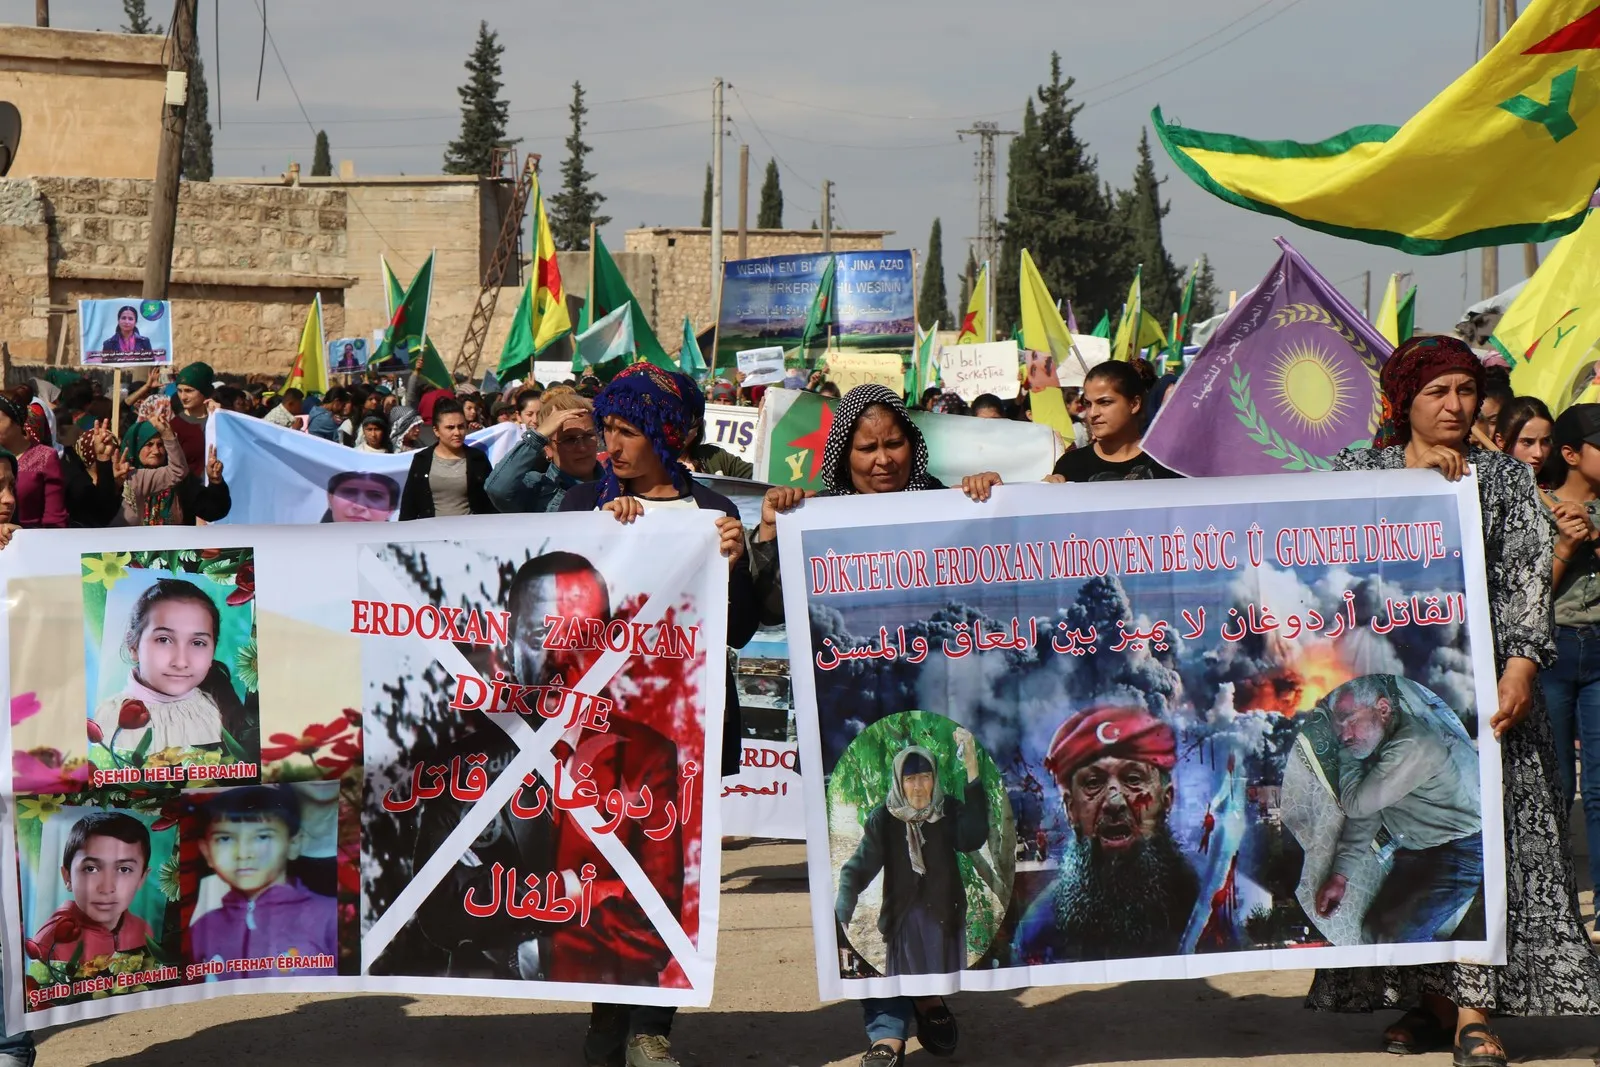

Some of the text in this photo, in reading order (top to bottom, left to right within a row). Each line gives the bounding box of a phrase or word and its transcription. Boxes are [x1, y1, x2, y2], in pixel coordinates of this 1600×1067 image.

[737, 263, 774, 275] WERIN
[779, 262, 796, 273] EM
[801, 261, 812, 273] BI
[850, 259, 876, 271] JINA
[880, 259, 904, 270] AZAD
[943, 349, 982, 369] Ji beli
[1215, 332, 1243, 365] الحرة
[1192, 363, 1222, 409] للشهباء
[933, 542, 1044, 587] ERDOXAN
[1159, 526, 1189, 572] BÊ
[1192, 523, 1237, 571] SÛC
[1247, 522, 1264, 568] Û
[1275, 525, 1360, 569] GUNEH
[350, 599, 699, 660] ERDOXAN ZAROKAN
[816, 590, 1465, 671] القاتل أردوغان لا يميز بين المعاق والمسن
[94, 761, 257, 788] ŞEHÎD HELE ÊBRAHÎM
[381, 752, 698, 841] أردوغان قاتل
[463, 862, 598, 927] أطفال
[30, 966, 178, 1007] ŞEHÎD HISÊN ÊBRAHÎM
[186, 953, 335, 980] ŞEHÎD FERHAT ÊBRAHÎM
